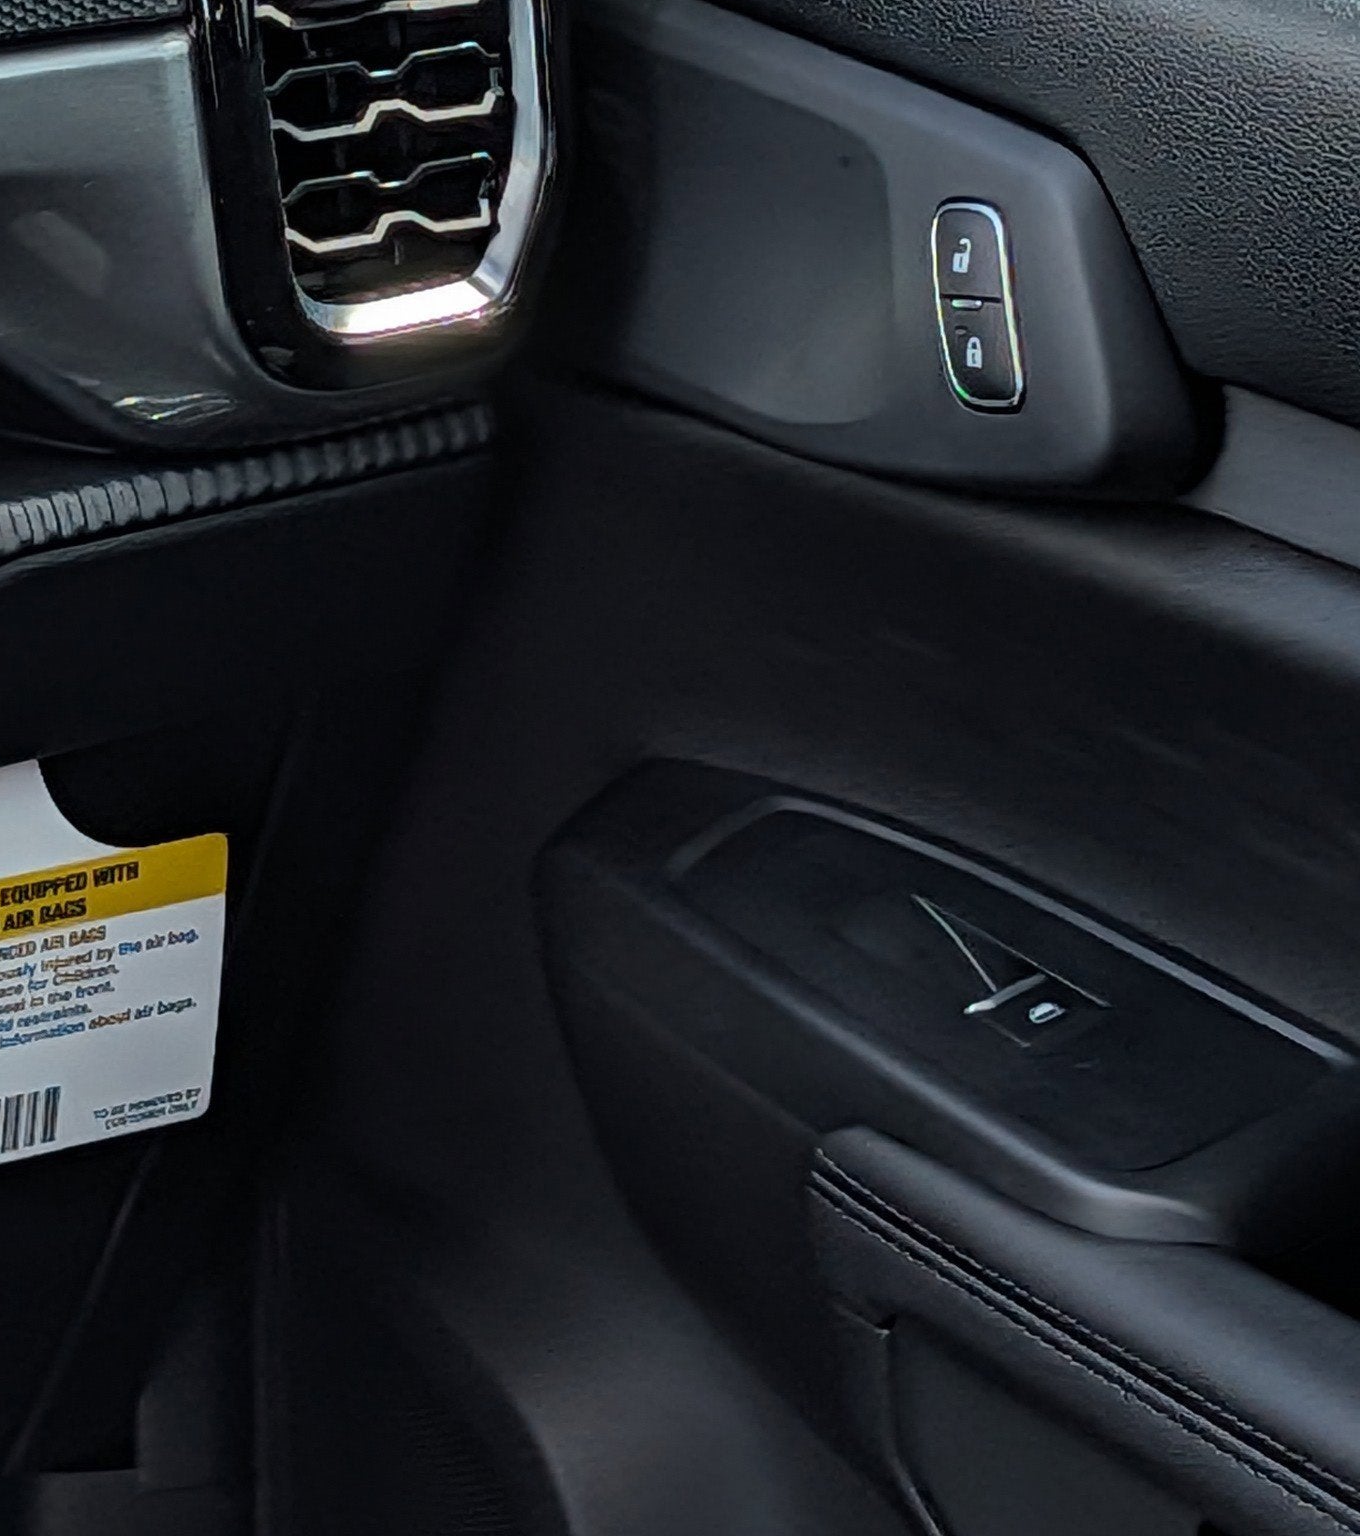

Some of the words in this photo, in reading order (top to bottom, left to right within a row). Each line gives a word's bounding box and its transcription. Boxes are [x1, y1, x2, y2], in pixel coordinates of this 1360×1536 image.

[0, 871, 87, 907] EQUIPPED
[92, 861, 138, 887] WITH
[2, 909, 33, 932] AIR
[38, 898, 86, 924] BAGS
[40, 934, 63, 953] AIR
[68, 925, 105, 947] BAGS
